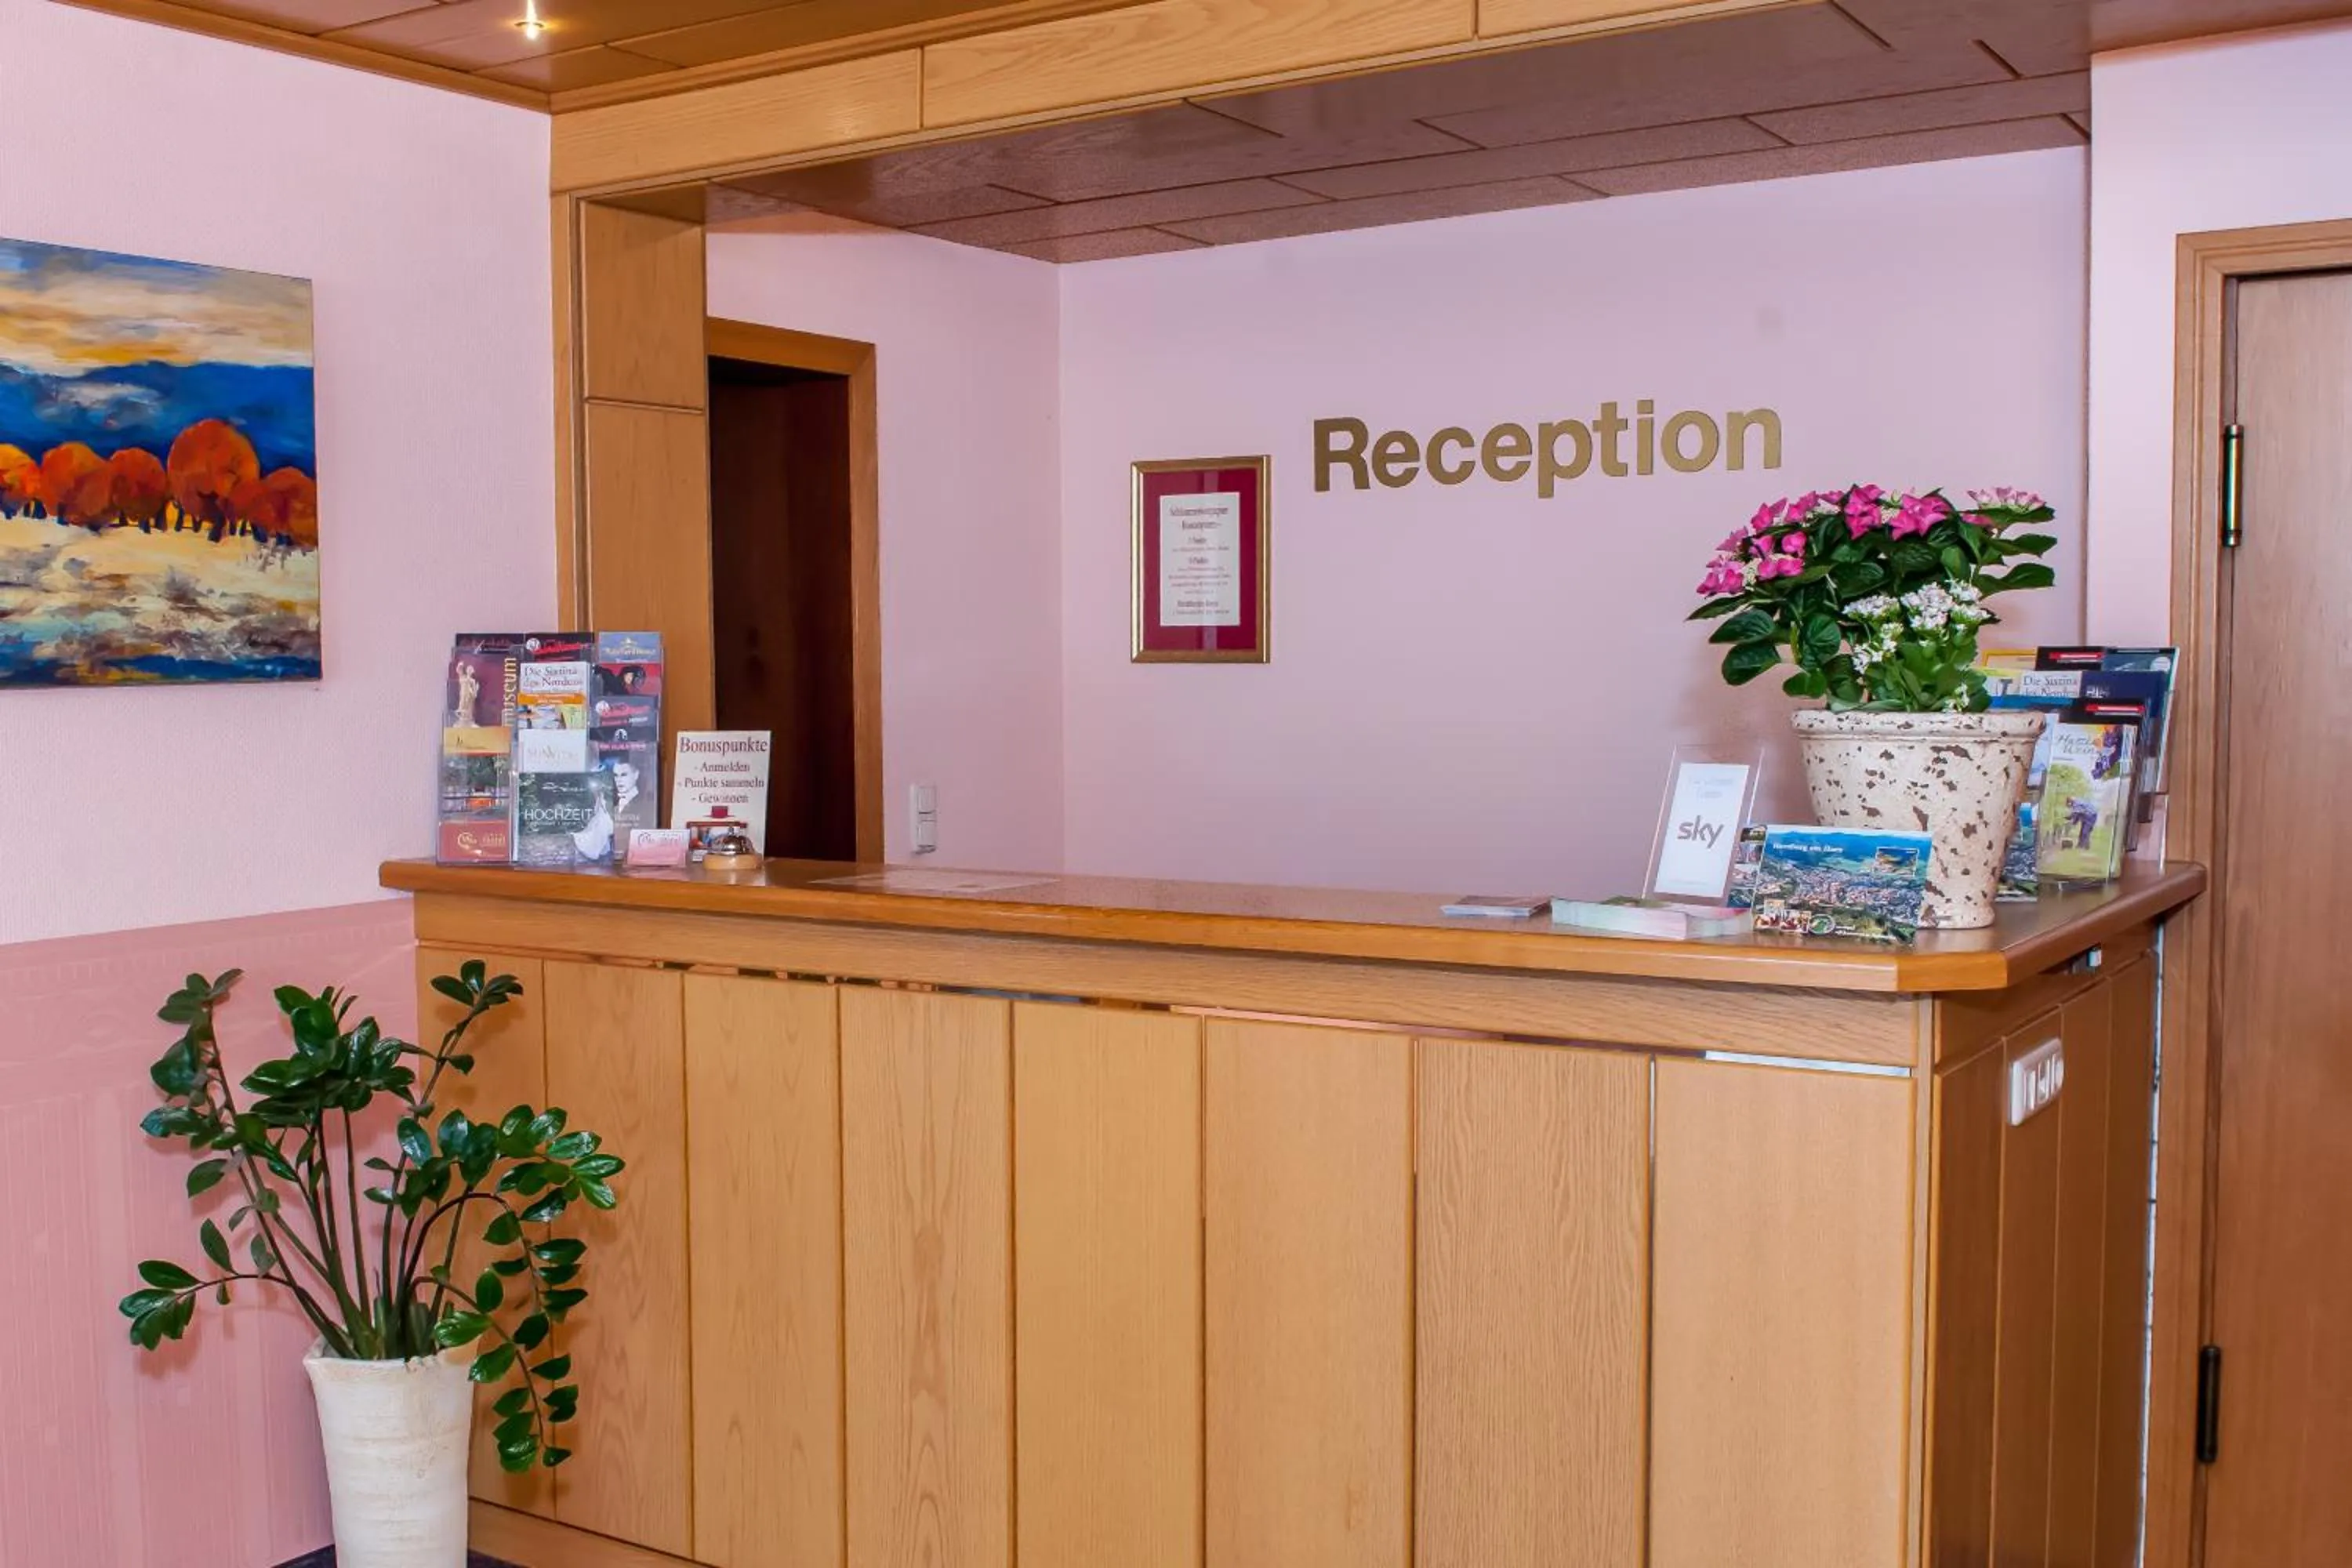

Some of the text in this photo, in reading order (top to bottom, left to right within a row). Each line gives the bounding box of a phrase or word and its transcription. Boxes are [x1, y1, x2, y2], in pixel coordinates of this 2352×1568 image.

[1314, 399, 1782, 499] Reception
[2023, 676, 2042, 686] Die
[680, 736, 768, 757] Bonuspunkte
[700, 760, 750, 773] Anmelden
[684, 777, 718, 789] Punkte
[720, 776, 765, 789] sammeln
[699, 793, 750, 804] Gewinnen
[524, 808, 593, 821] HOCHZEIT
[1677, 815, 1725, 850] sky
